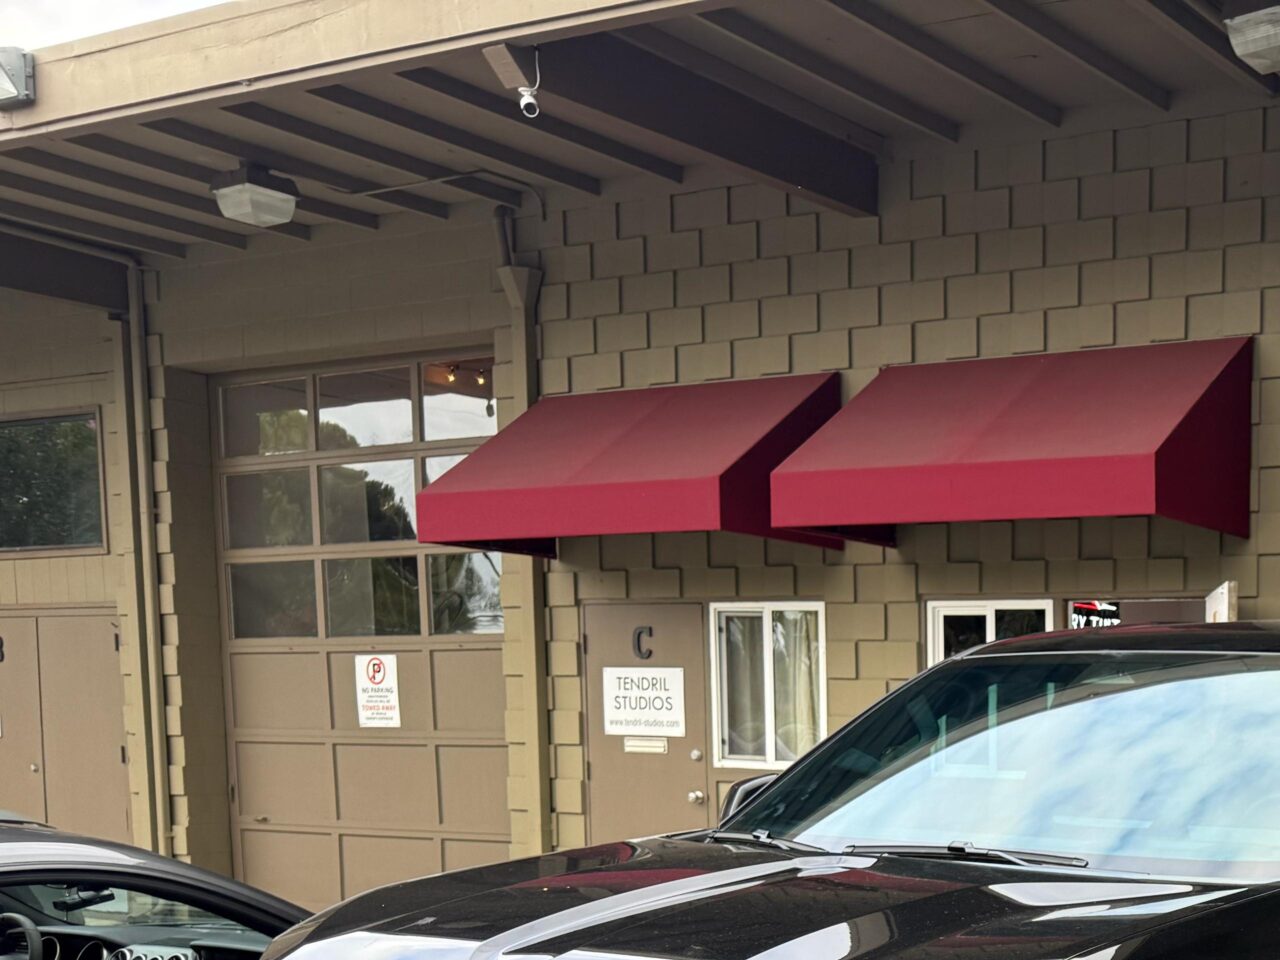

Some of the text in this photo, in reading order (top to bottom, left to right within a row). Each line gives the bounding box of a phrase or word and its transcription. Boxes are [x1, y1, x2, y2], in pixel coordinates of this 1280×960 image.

[632, 626, 653, 660] C
[616, 676, 670, 692] TENDRIL
[614, 695, 673, 711] STUDIOS
